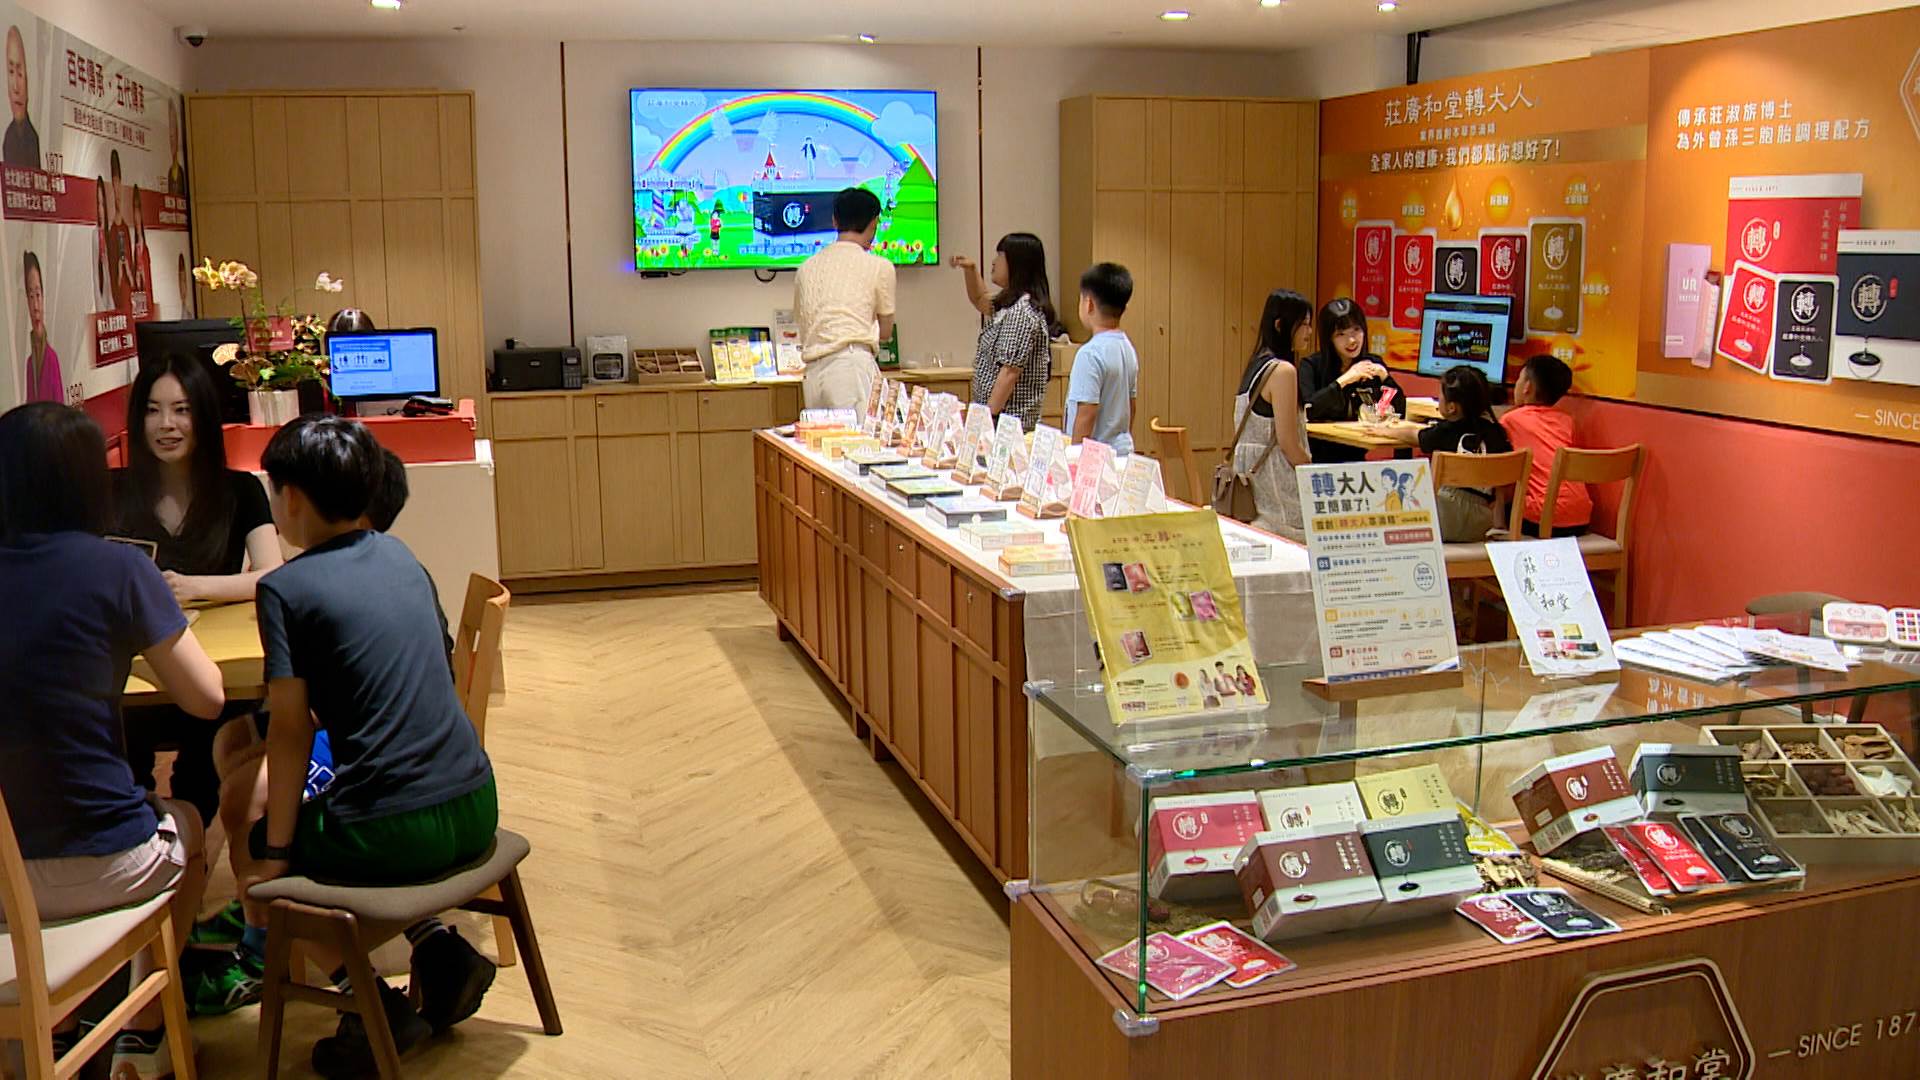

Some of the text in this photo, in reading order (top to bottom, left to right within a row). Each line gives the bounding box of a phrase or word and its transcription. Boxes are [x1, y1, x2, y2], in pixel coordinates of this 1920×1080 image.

[1384, 83, 1533, 127] 莊廣和堂轉大人
[1676, 119, 1870, 150] 為外曾孫三胞胎調理配方
[1747, 224, 1767, 255] 轉
[1856, 283, 1881, 313] 轉
[1874, 408, 1920, 431] SINCE
[1311, 471, 1375, 498] 轉大人
[1798, 1023, 1863, 1058] SINCE
